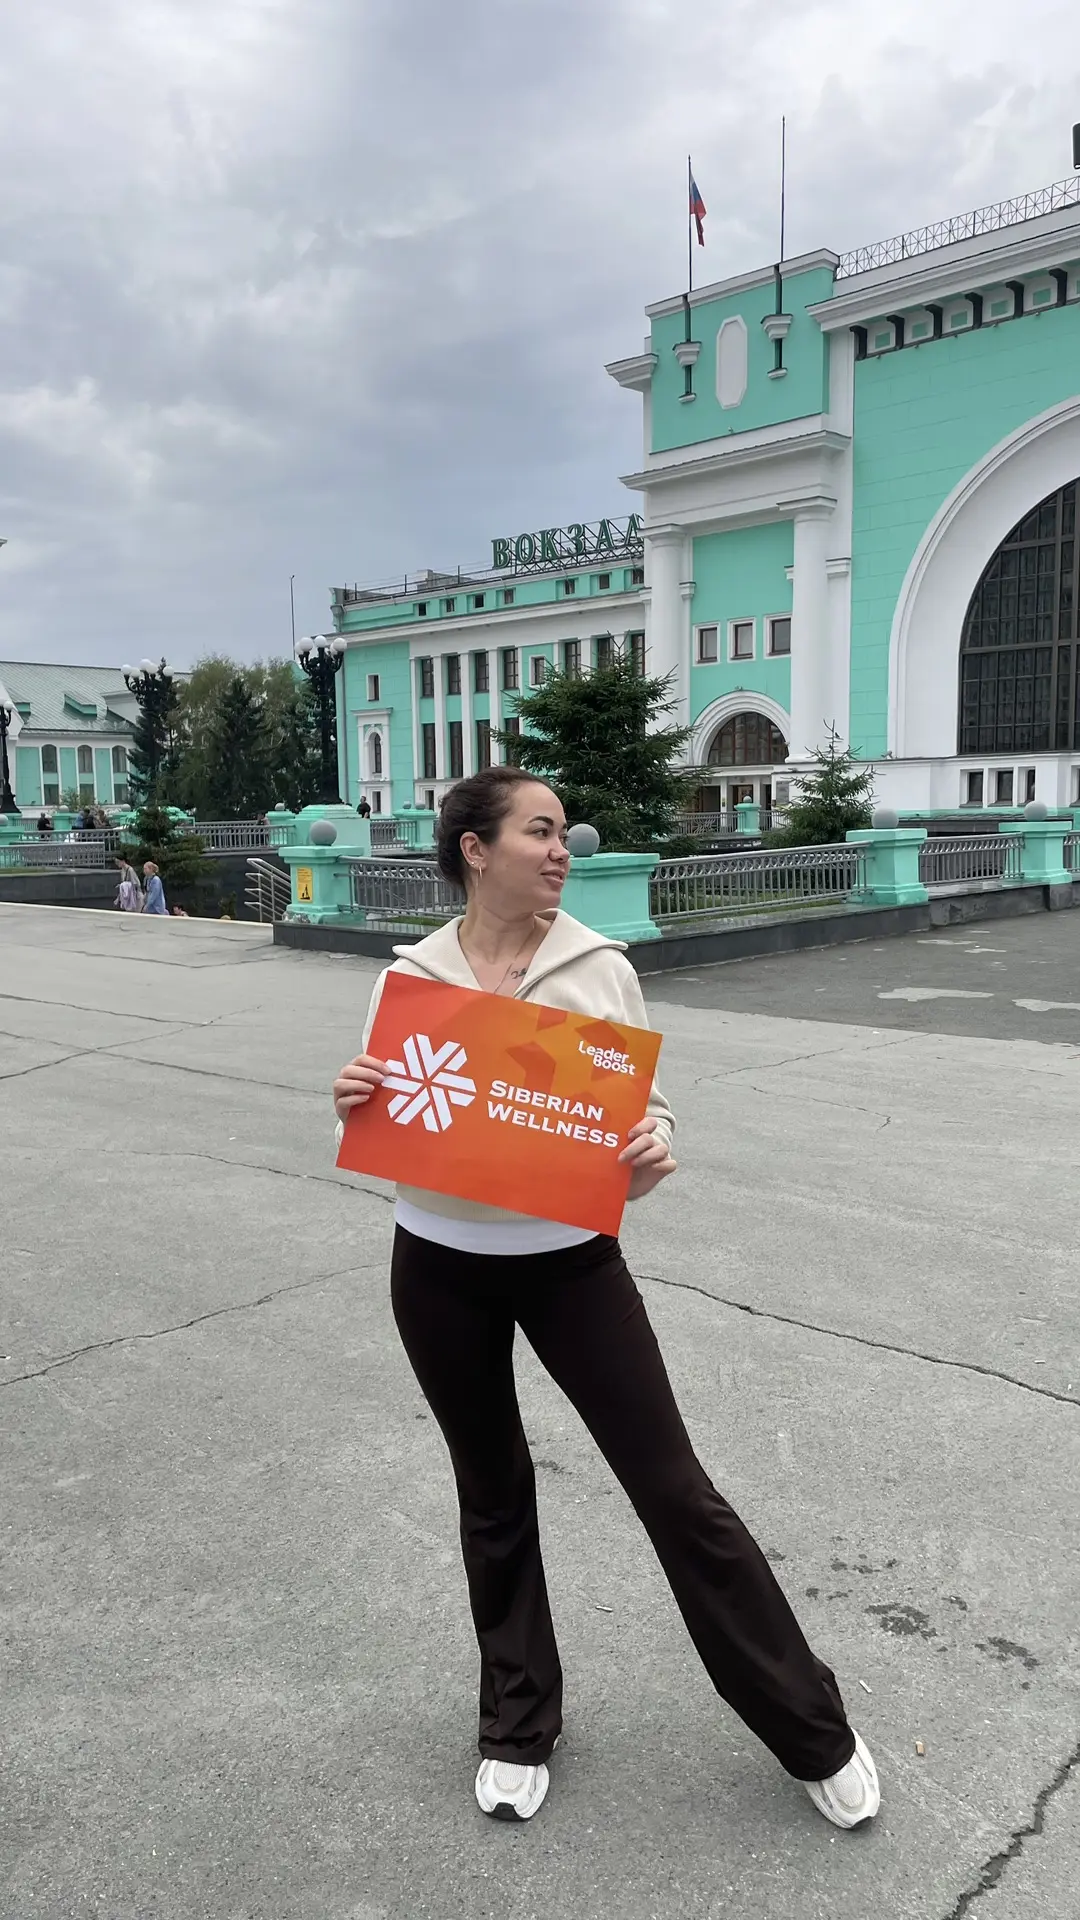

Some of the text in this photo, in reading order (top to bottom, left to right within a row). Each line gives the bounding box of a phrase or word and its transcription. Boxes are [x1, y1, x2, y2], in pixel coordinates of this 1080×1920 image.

[578, 1040, 630, 1064] Leader
[593, 1054, 636, 1076] Boost
[489, 1079, 604, 1122] SIBERIAN
[486, 1100, 620, 1148] WELLNESS
